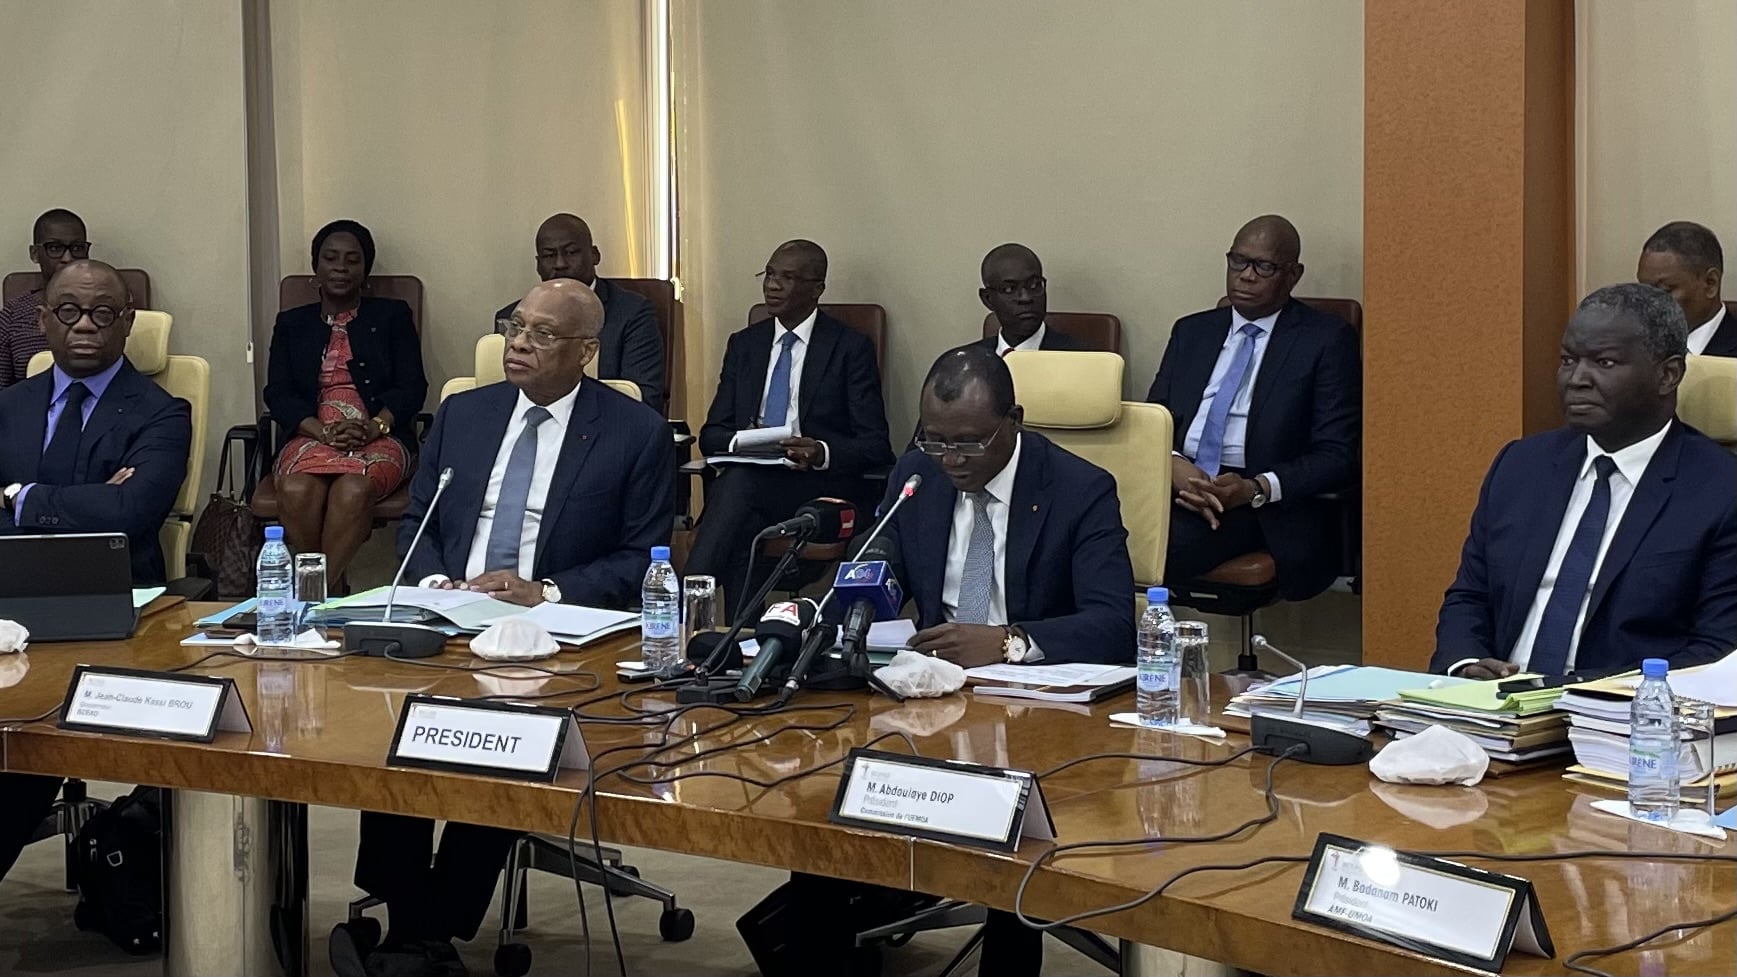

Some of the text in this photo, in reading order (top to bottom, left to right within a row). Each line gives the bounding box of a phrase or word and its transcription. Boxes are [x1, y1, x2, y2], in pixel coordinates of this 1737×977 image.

[412, 726, 522, 753] PRESIDENT
[866, 781, 954, 804] M. Abdoulaye DIOP
[1338, 876, 1439, 912] M. Badanam PATOKI
